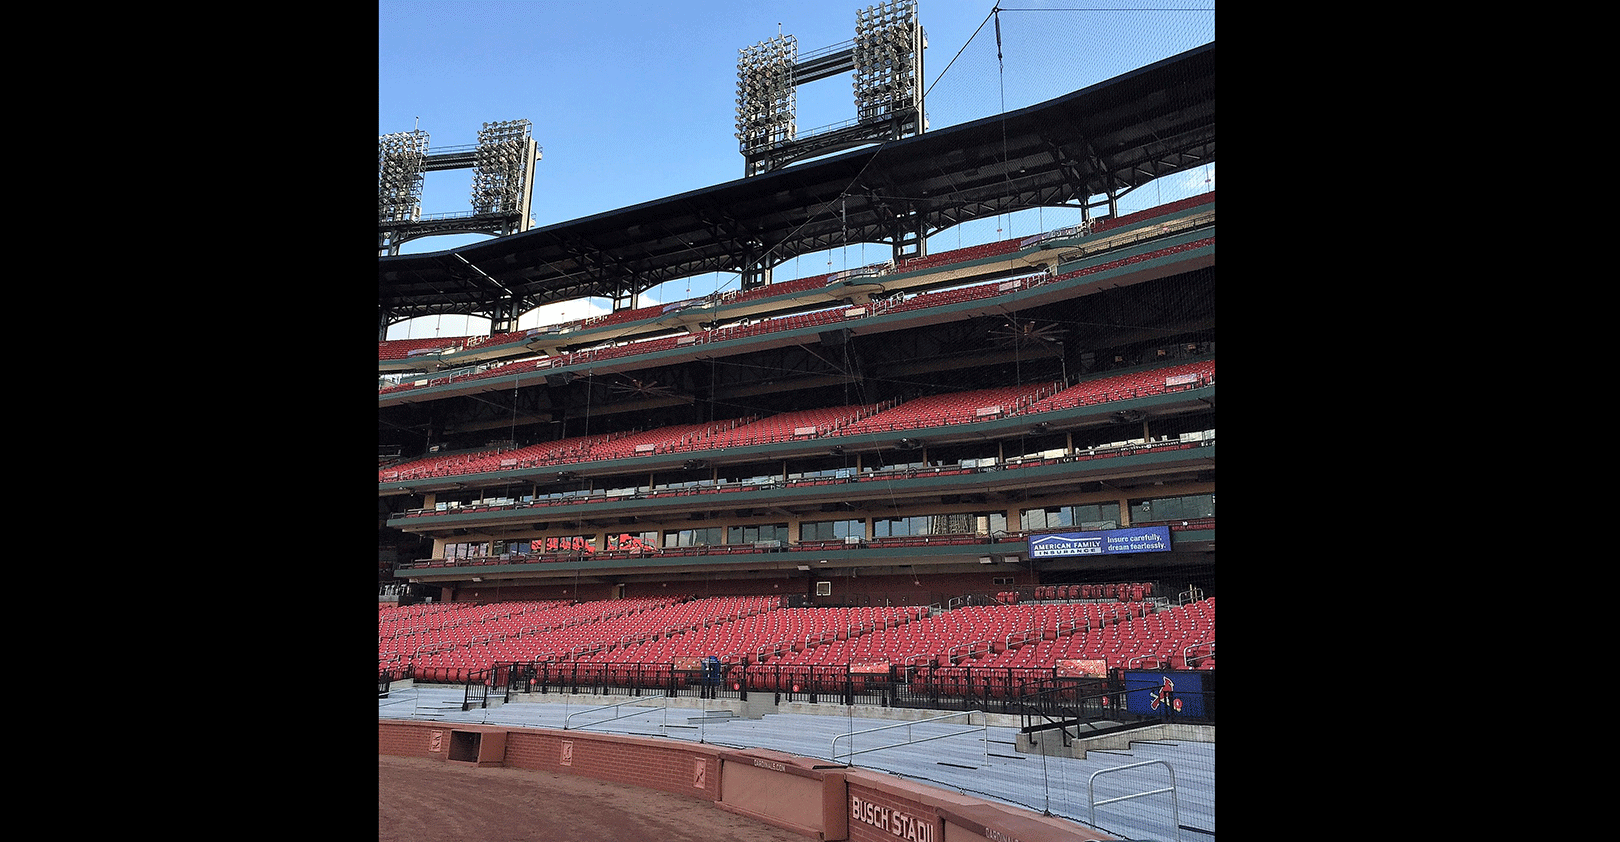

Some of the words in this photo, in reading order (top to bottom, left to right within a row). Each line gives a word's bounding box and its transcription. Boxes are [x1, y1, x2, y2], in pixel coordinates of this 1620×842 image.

[1034, 543, 1071, 551] AMERICAN
[1073, 540, 1101, 548] FAMILY
[1130, 541, 1167, 550] fearlessly.
[1039, 548, 1096, 556] INSURANCE
[852, 796, 890, 833] BUSCH
[892, 810, 934, 842] STADI
